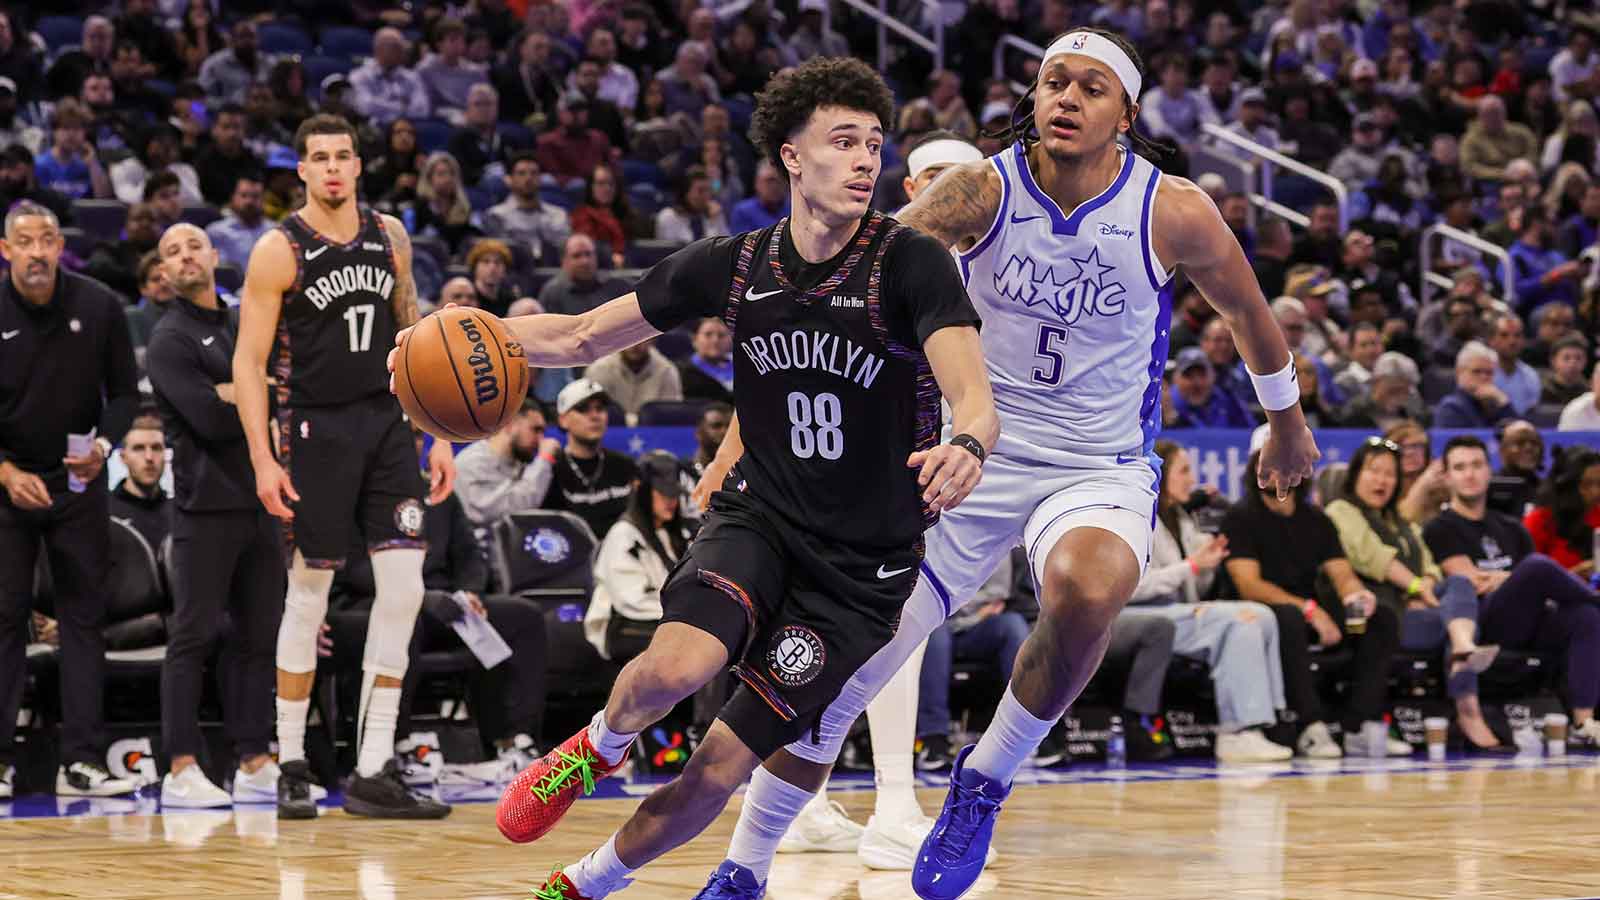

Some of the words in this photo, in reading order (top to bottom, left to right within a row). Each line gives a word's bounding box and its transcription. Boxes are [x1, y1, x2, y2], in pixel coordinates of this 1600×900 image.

[1097, 222, 1135, 240] Disney
[304, 264, 395, 310] BROOKLYN
[830, 295, 842, 307] All
[343, 304, 375, 353] 17
[458, 318, 499, 406] Wilson
[741, 331, 885, 389] BROOKLYN
[1032, 322, 1069, 388] 5
[787, 391, 844, 460] 88
[783, 629, 822, 666] BROOKLYN
